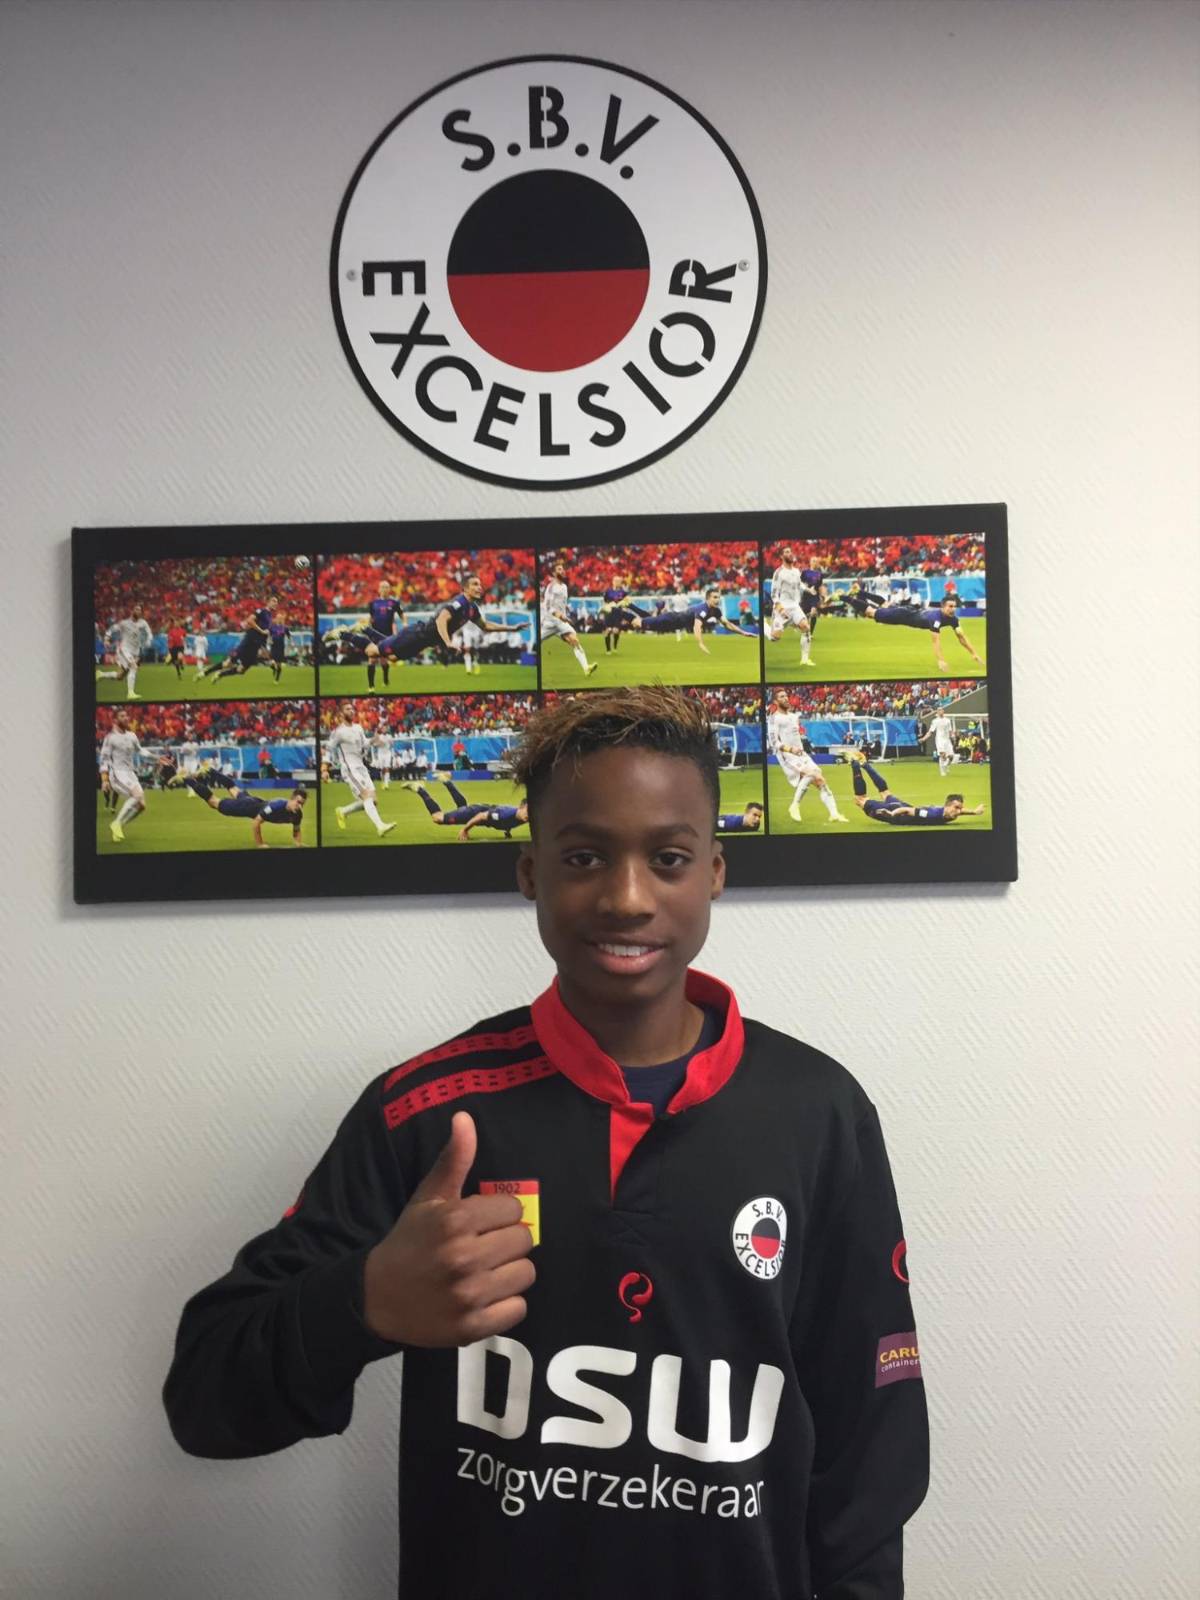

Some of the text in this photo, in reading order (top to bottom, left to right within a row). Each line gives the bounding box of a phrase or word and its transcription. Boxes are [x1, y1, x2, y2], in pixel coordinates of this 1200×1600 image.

[441, 85, 660, 180] S.B.V.
[361, 259, 738, 457] EXCELSIOR
[494, 1183, 520, 1193] 1902
[457, 1335, 785, 1464] DSW
[457, 1447, 765, 1517] zorgverzekeraar
